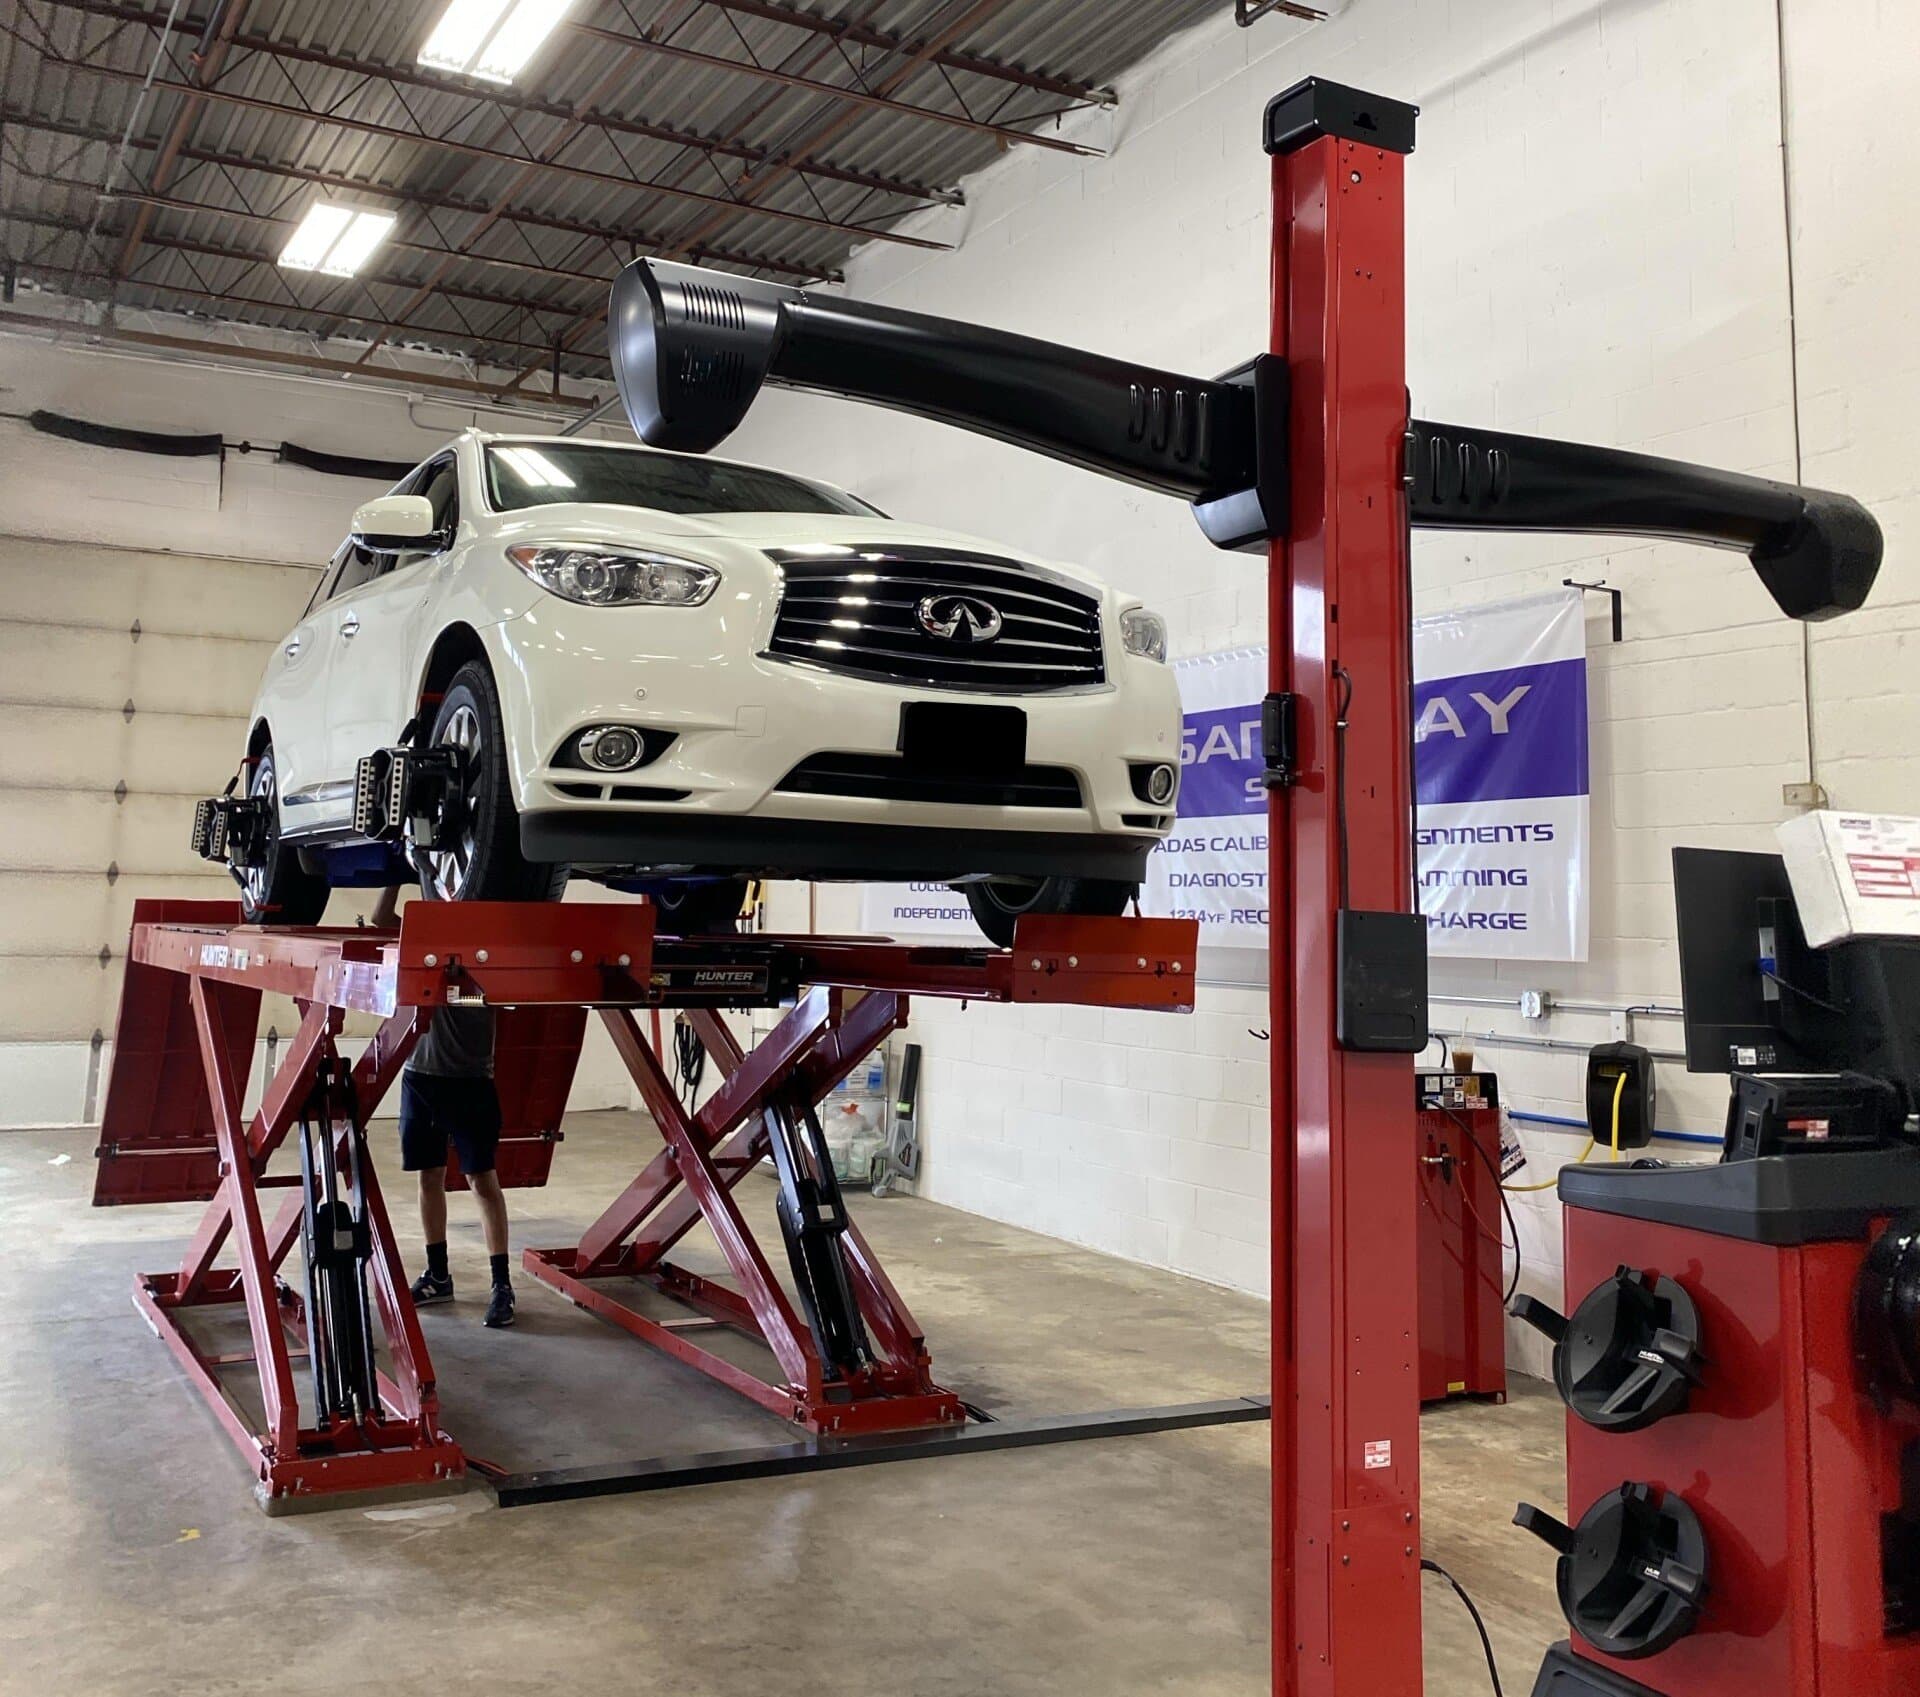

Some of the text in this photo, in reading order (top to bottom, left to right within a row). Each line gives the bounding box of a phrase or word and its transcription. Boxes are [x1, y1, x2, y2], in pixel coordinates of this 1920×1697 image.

[1180, 685, 1532, 765] SAN AY
[1154, 824, 1554, 852] ADAS CALIB GNMENTS
[910, 882, 951, 892] COLLIS
[1169, 869, 1528, 887] DIAGNOST MMING
[894, 907, 973, 920] INDEPENDENT
[1231, 909, 1269, 924] REC
[1427, 912, 1528, 930] HARGE
[695, 971, 754, 980] HUNTER
